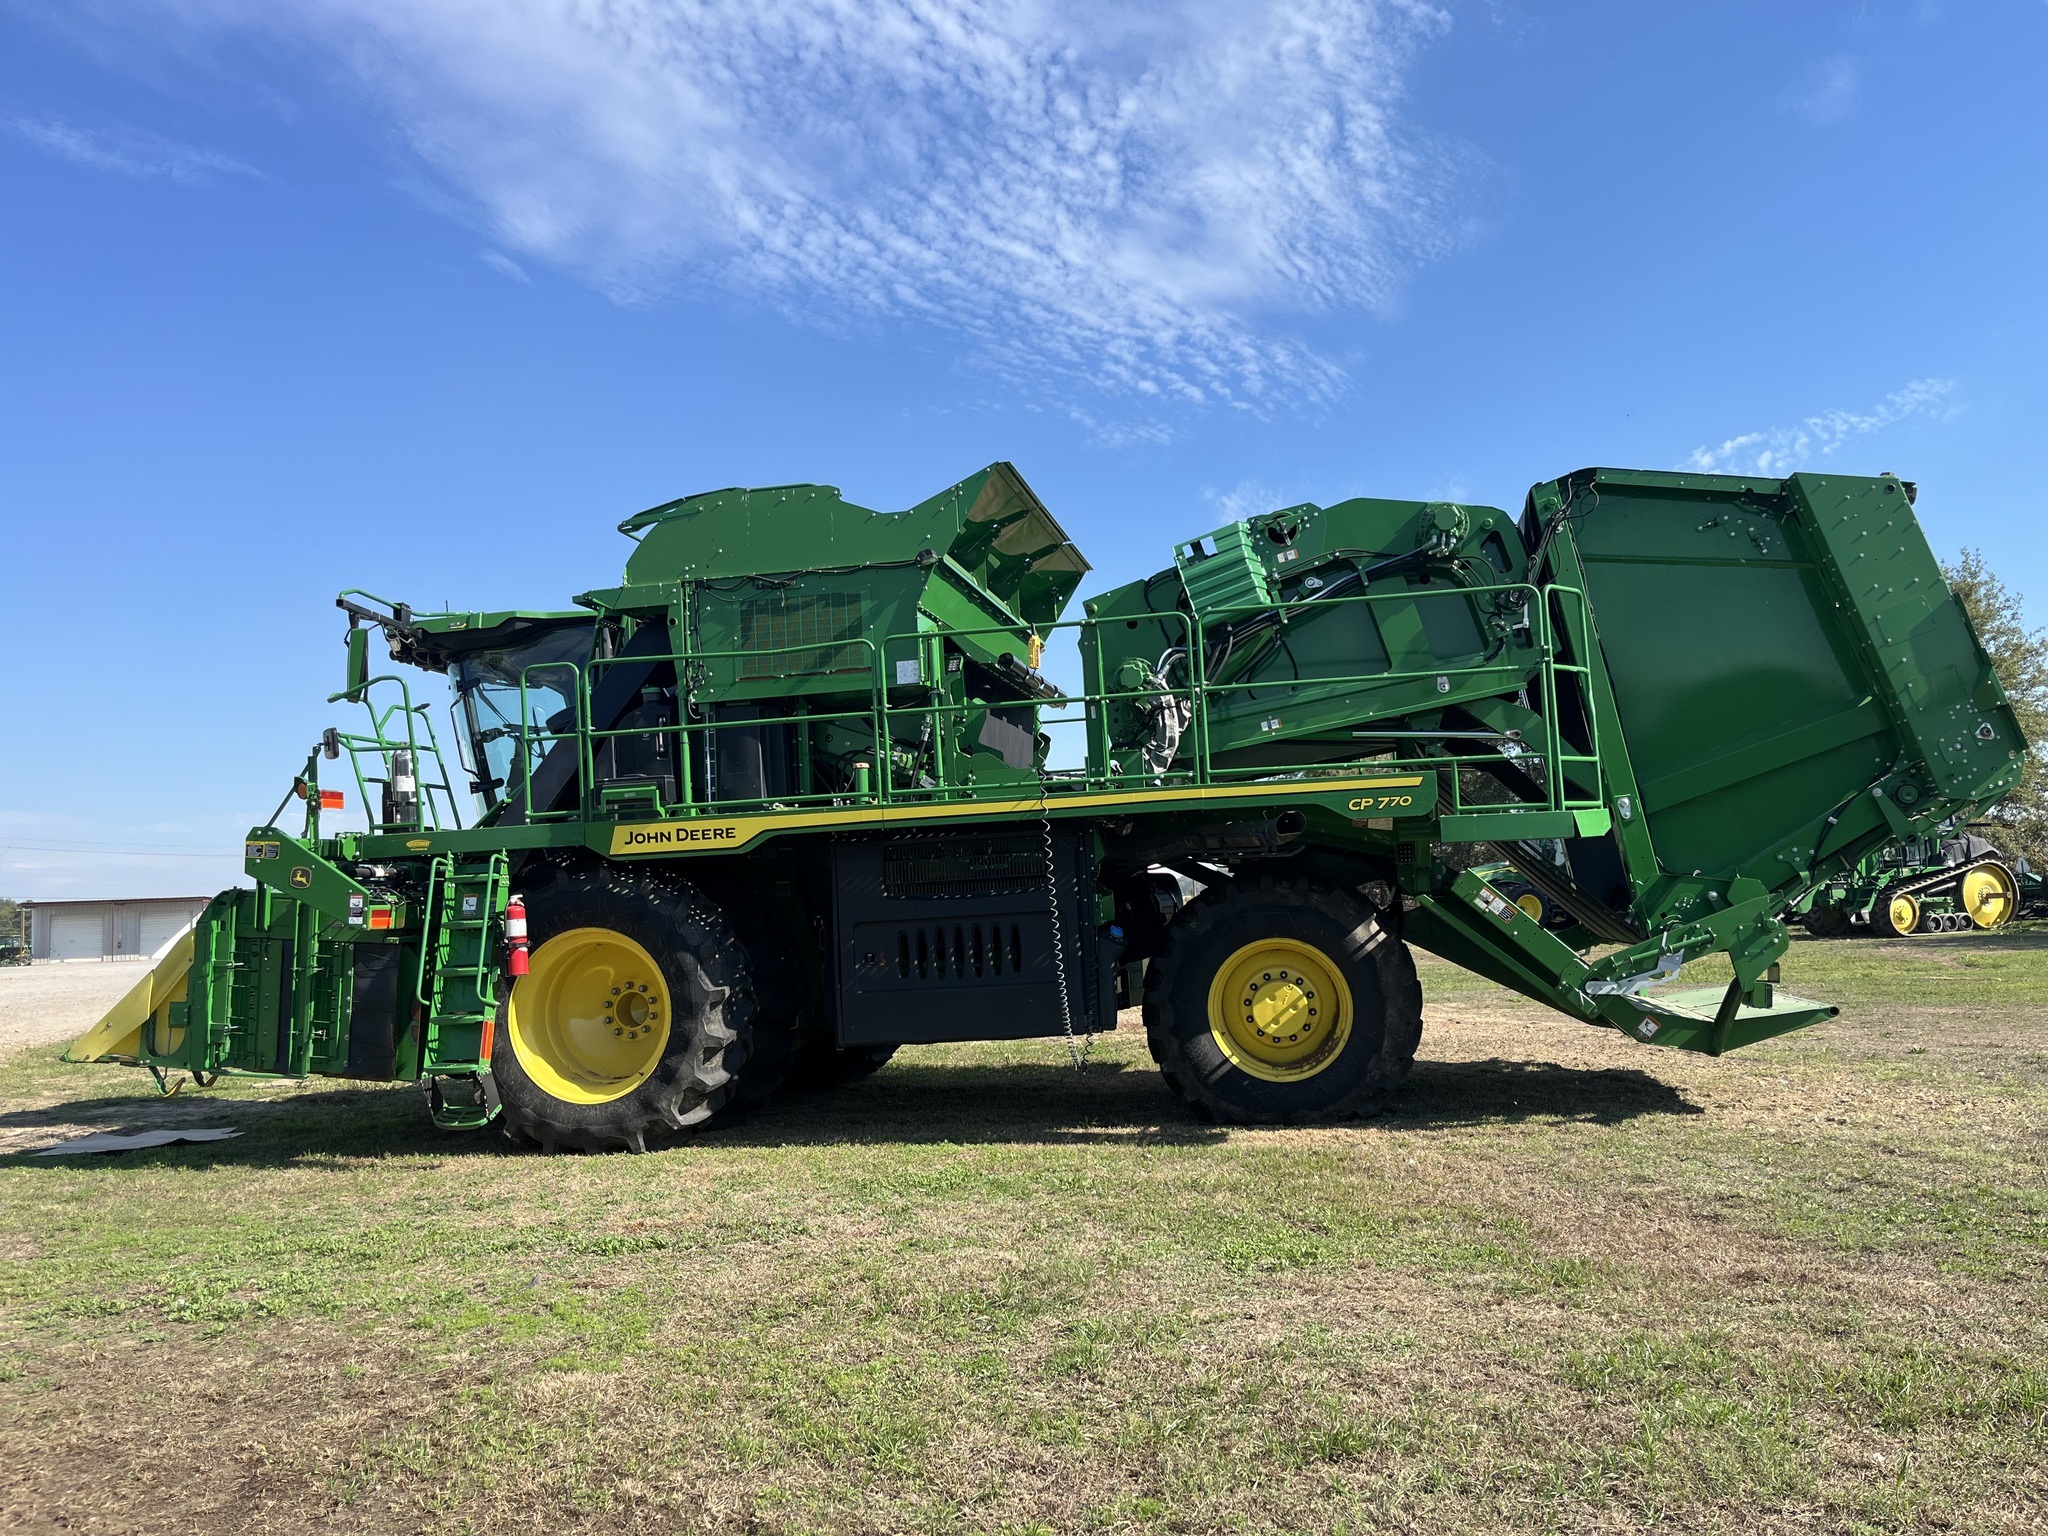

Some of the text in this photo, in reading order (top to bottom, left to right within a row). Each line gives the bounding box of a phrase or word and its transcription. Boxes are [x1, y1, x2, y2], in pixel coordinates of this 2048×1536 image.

[1348, 796, 1412, 811] CP 770
[624, 828, 736, 845] JOHN DEERE
